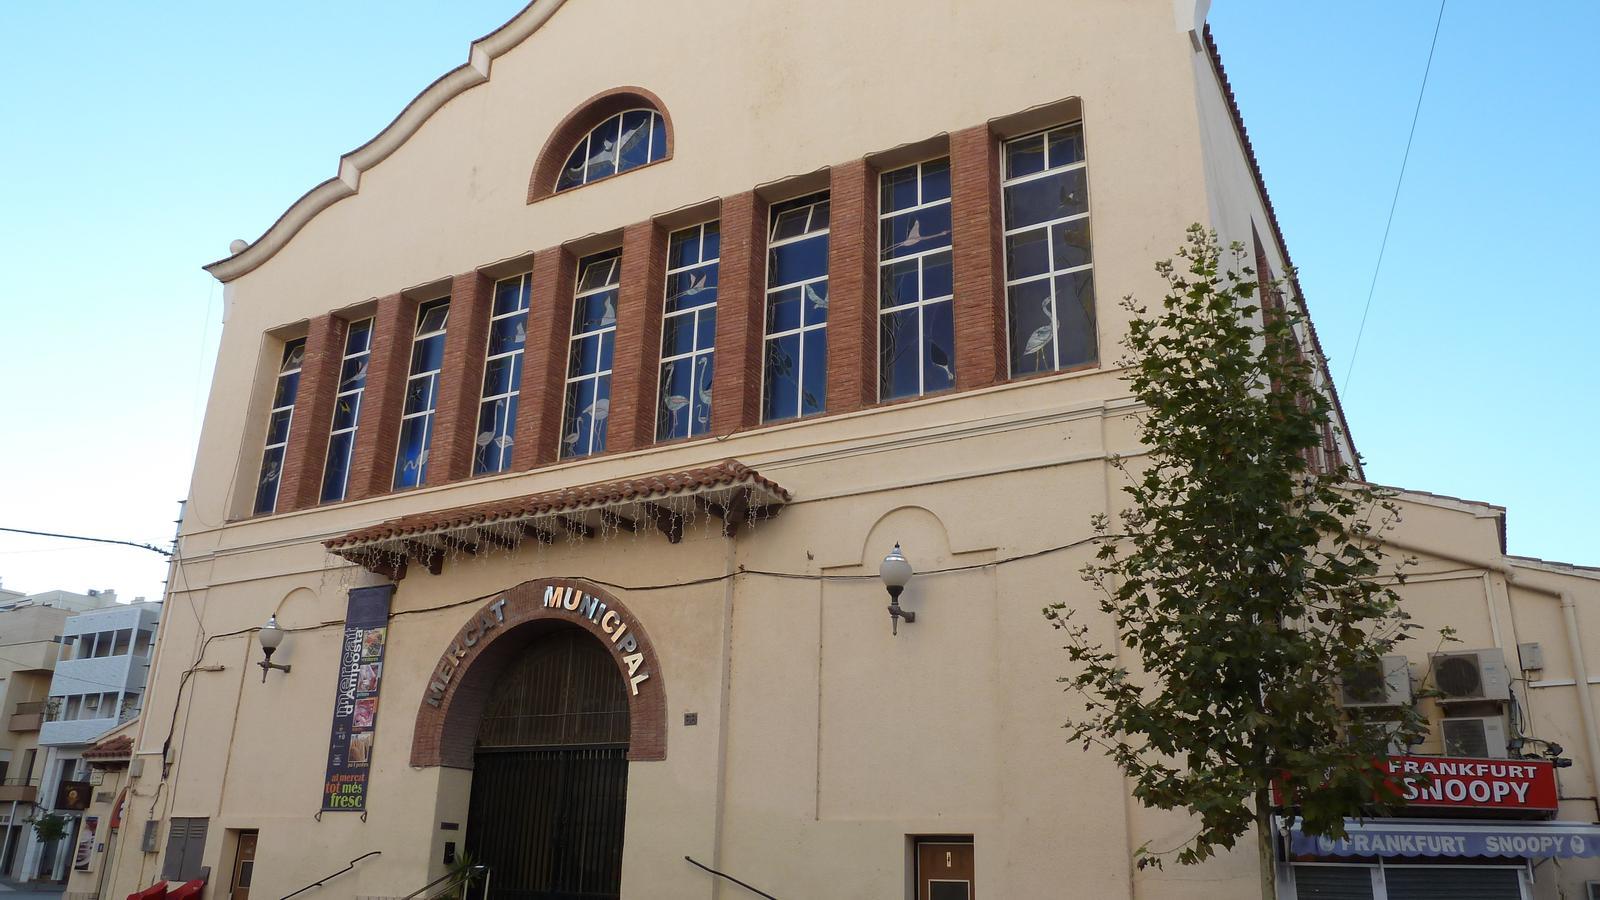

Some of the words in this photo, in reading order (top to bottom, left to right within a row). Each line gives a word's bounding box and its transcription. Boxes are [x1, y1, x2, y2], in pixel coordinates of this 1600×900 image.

[427, 599, 507, 708] MERCAT
[543, 585, 650, 696] MUNICIPAL
[344, 628, 363, 715] d'Amposta
[1388, 760, 1537, 779] FRANKFURT
[325, 781, 341, 794] tot
[342, 781, 362, 794] més
[1402, 777, 1530, 803] SNOOPY
[330, 792, 363, 808] fresc
[1341, 834, 1466, 853] FRANKFURT
[1485, 836, 1564, 853] SNOOPY
